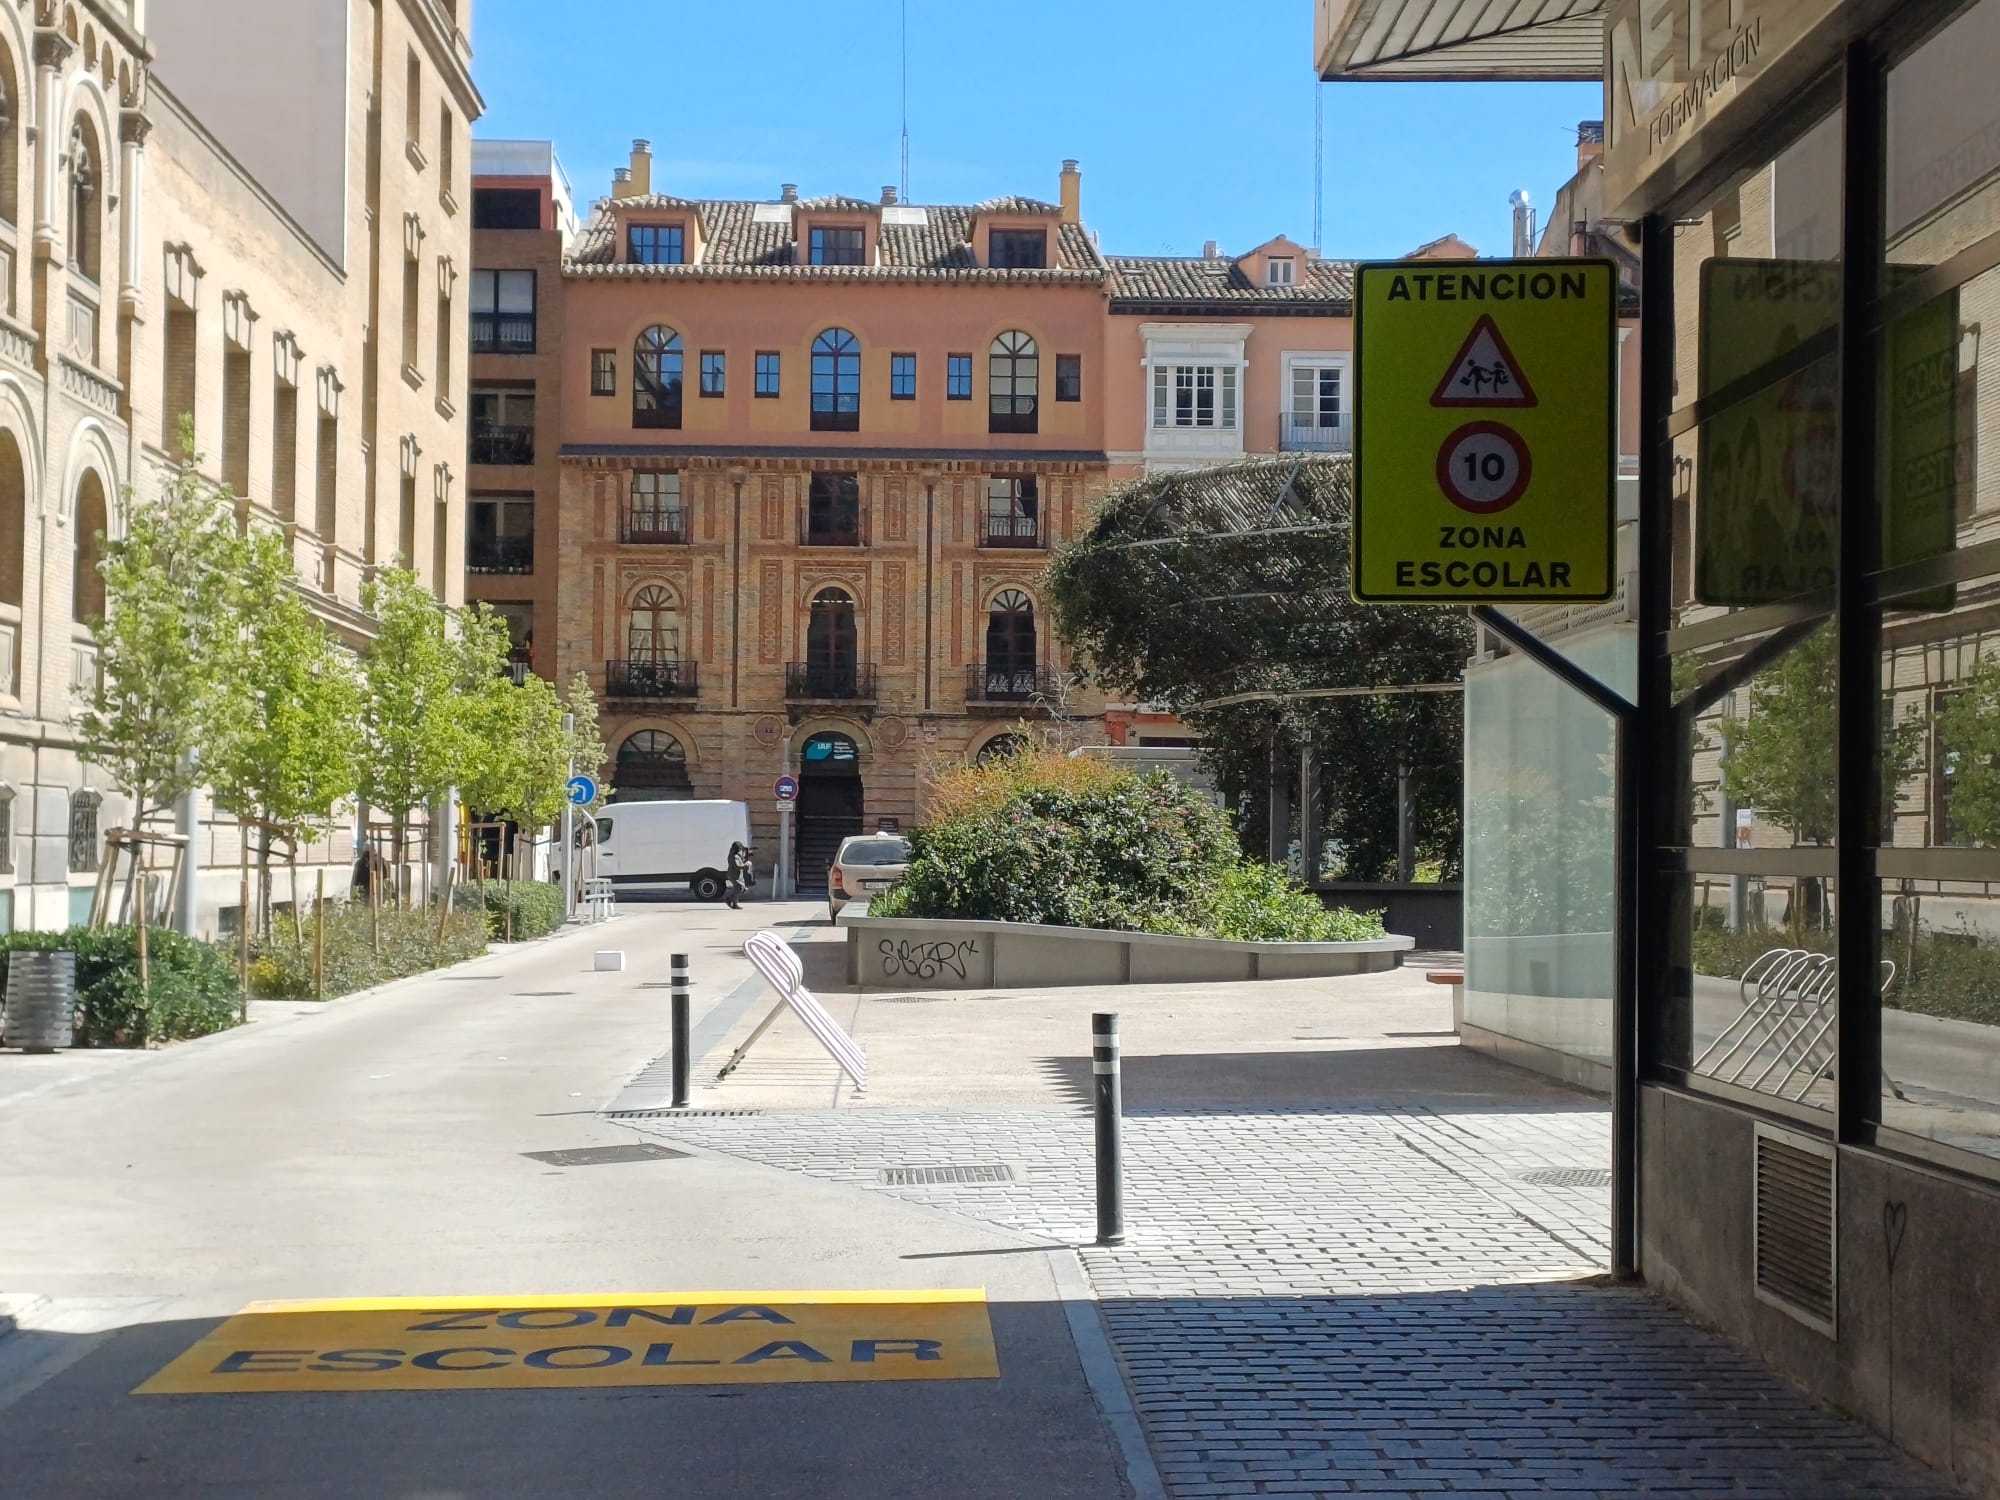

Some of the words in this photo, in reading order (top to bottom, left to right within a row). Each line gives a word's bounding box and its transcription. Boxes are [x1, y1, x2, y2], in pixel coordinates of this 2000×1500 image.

[1649, 16, 1760, 156] FORMACIÓN
[1387, 272, 1586, 301] ATENCION
[1463, 452, 1505, 482] 10
[1440, 526, 1526, 549] ZONA
[1396, 561, 1572, 588] ESCOLAR
[406, 1305, 797, 1331] ZONA
[209, 1338, 944, 1374] ESCOLAR
